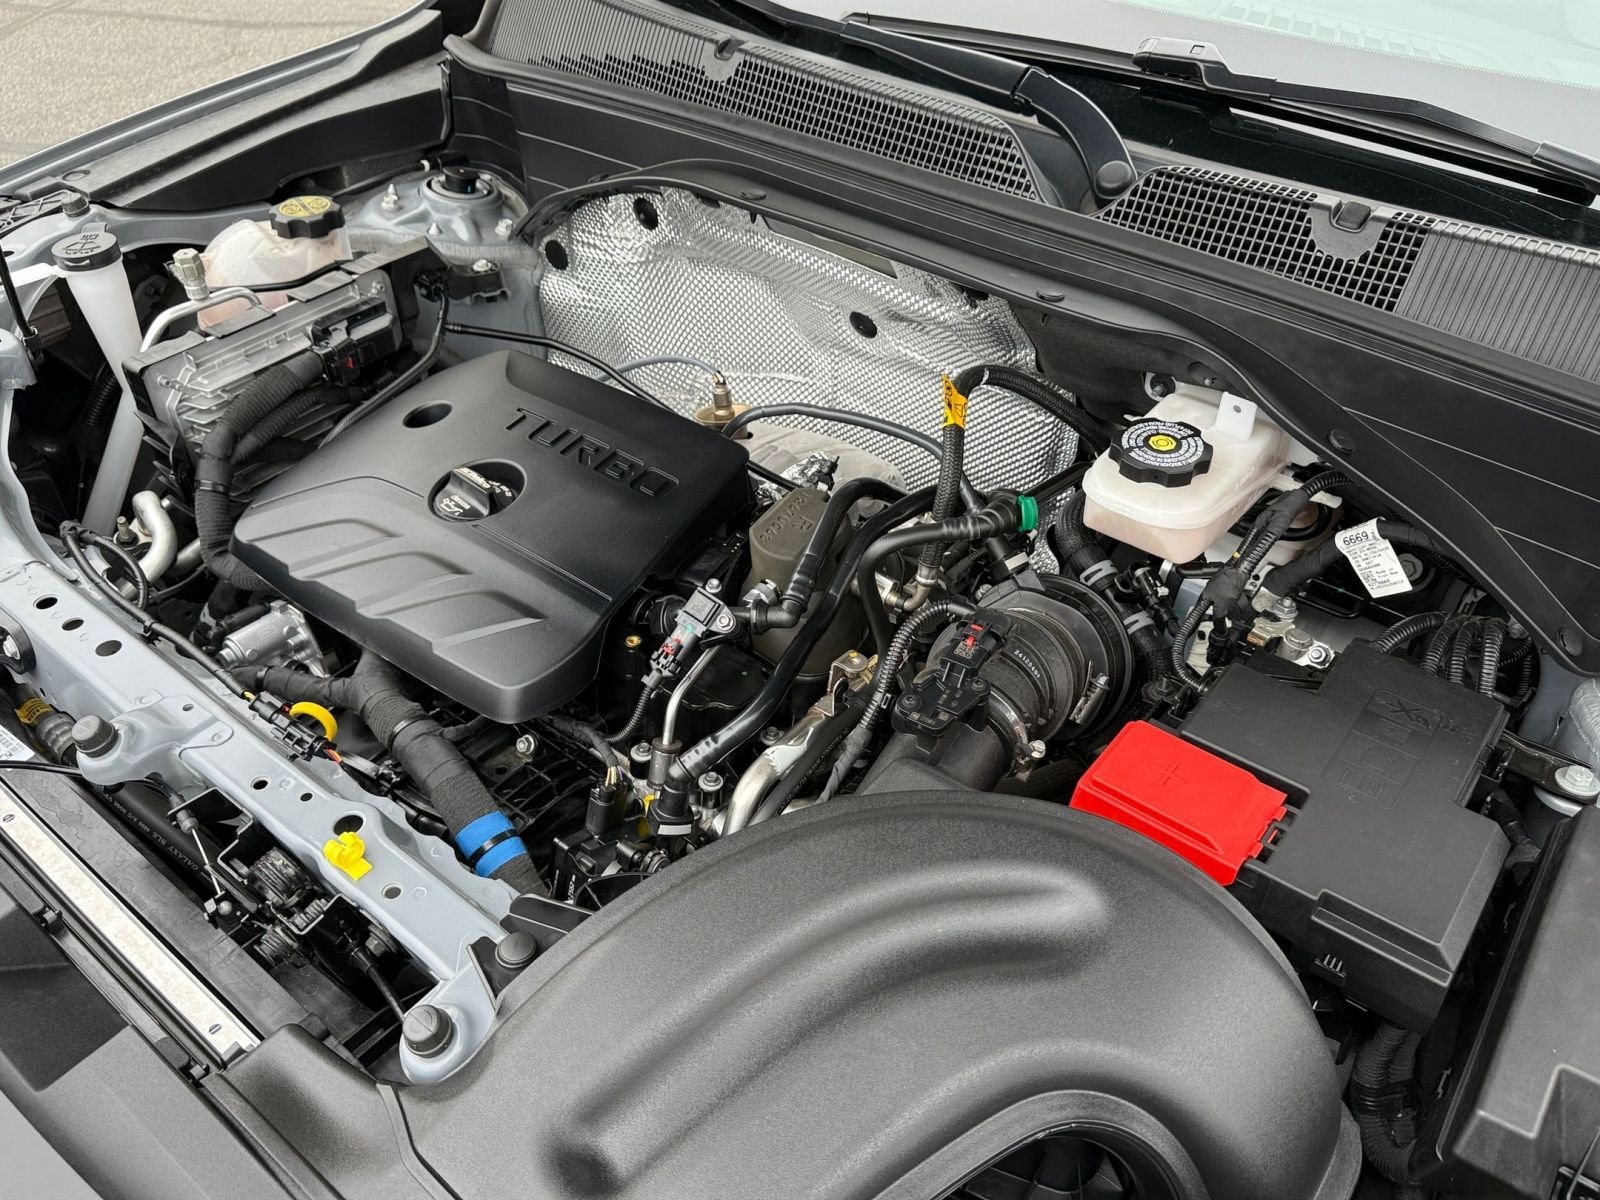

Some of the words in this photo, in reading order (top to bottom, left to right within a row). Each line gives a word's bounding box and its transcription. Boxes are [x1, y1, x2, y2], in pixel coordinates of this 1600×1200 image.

[505, 407, 680, 497] TURBO
[1342, 530, 1369, 546] 6669
[167, 845, 199, 871] GALAXY
